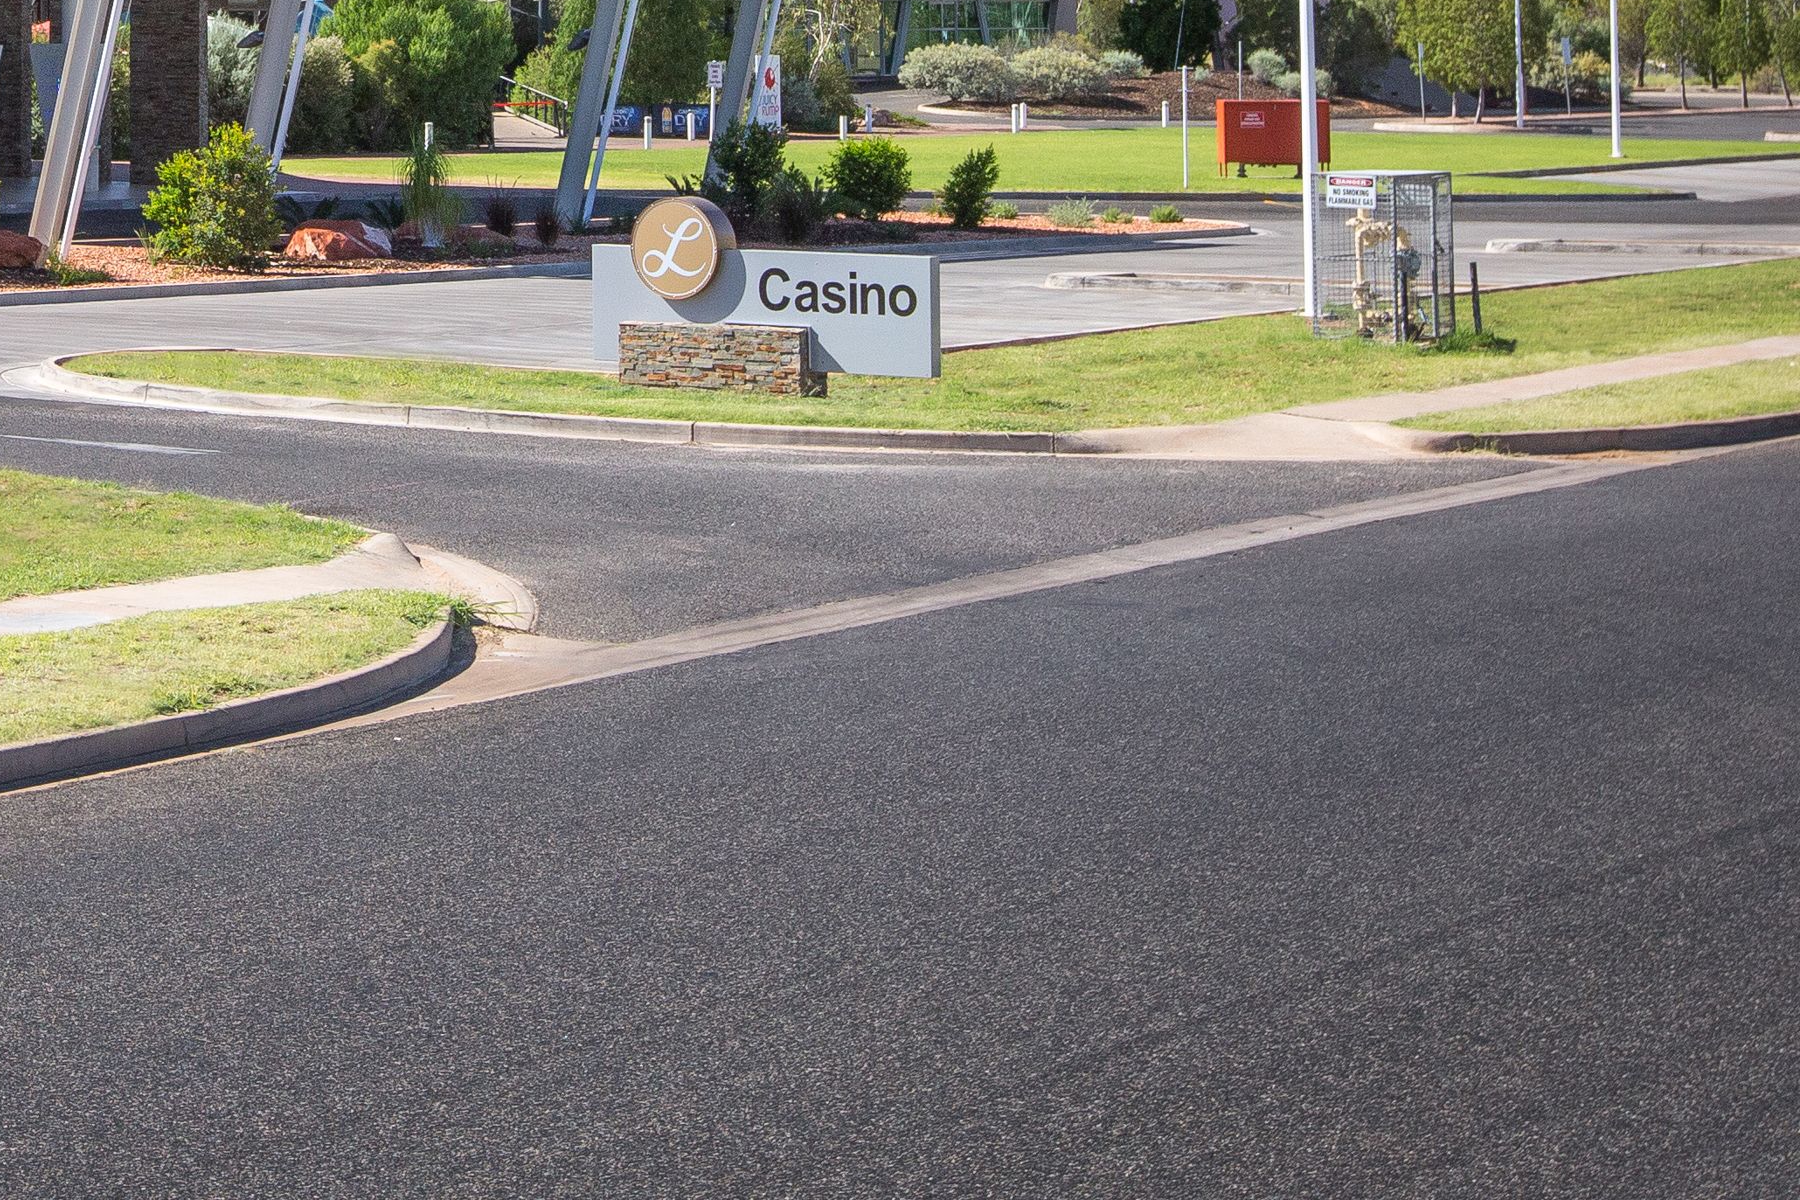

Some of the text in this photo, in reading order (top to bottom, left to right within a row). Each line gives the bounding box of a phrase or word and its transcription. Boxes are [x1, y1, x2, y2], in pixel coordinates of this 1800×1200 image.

[674, 114, 706, 127] DY
[1336, 178, 1367, 187] DANGER
[1333, 188, 1370, 197] NO SMOKING
[1328, 197, 1374, 206] FLAMMABLE GAS
[642, 216, 706, 277] L
[758, 267, 918, 317] Casino
